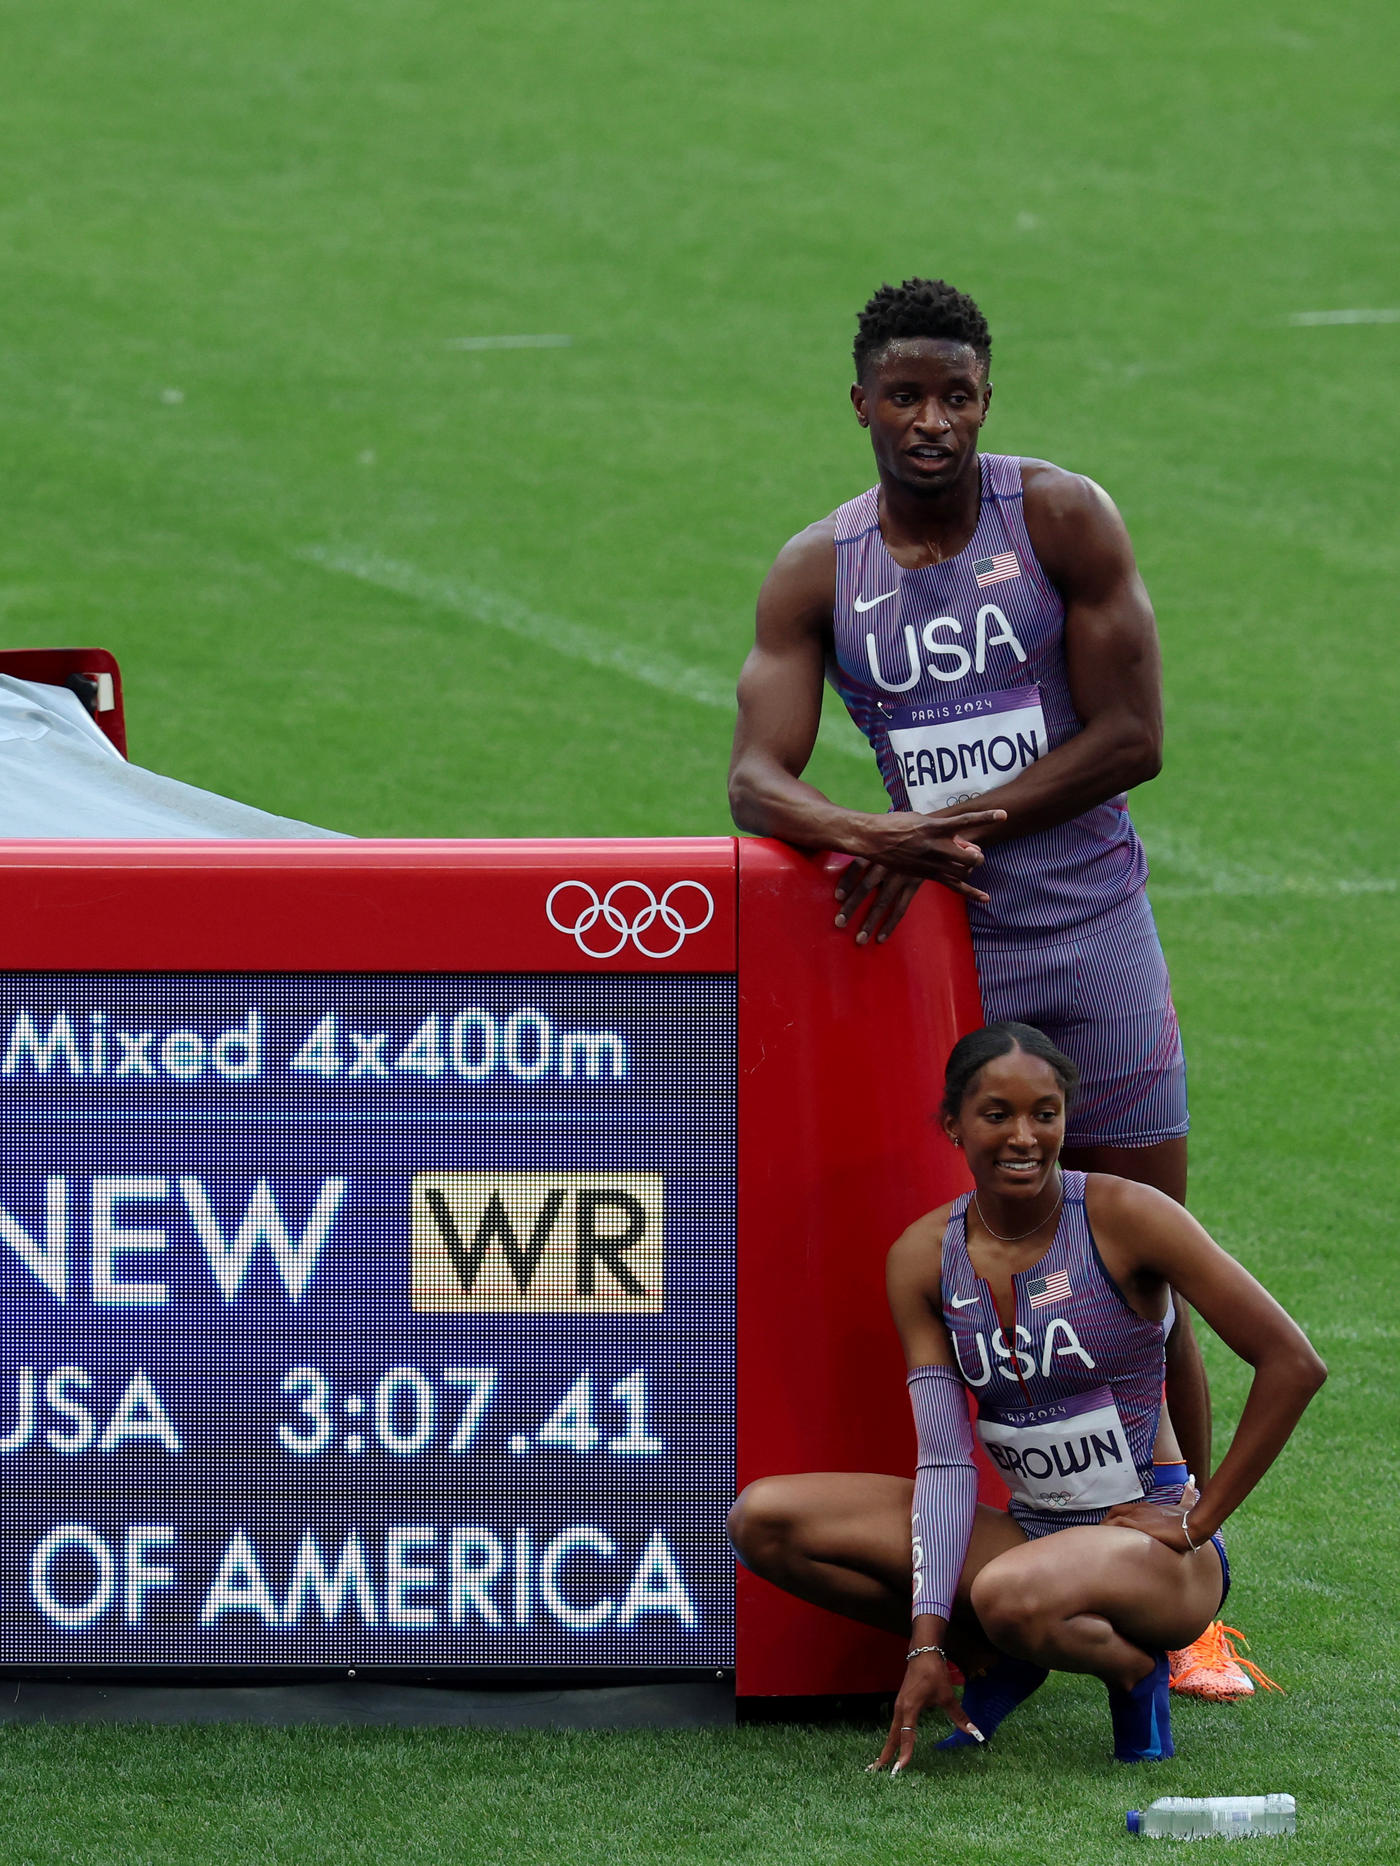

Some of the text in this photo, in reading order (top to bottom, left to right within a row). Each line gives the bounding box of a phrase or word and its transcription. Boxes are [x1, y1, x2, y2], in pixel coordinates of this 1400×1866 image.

[866, 604, 1027, 692] USA
[1, 1007, 629, 1081] Mixed 4x400m
[424, 1187, 647, 1295] WR
[952, 1318, 1095, 1387] USA
[277, 1365, 663, 1456] 3:07.41
[985, 1429, 1122, 1480] BROWN
[30, 1524, 176, 1630] OF
[200, 1526, 699, 1631] AMERICA
